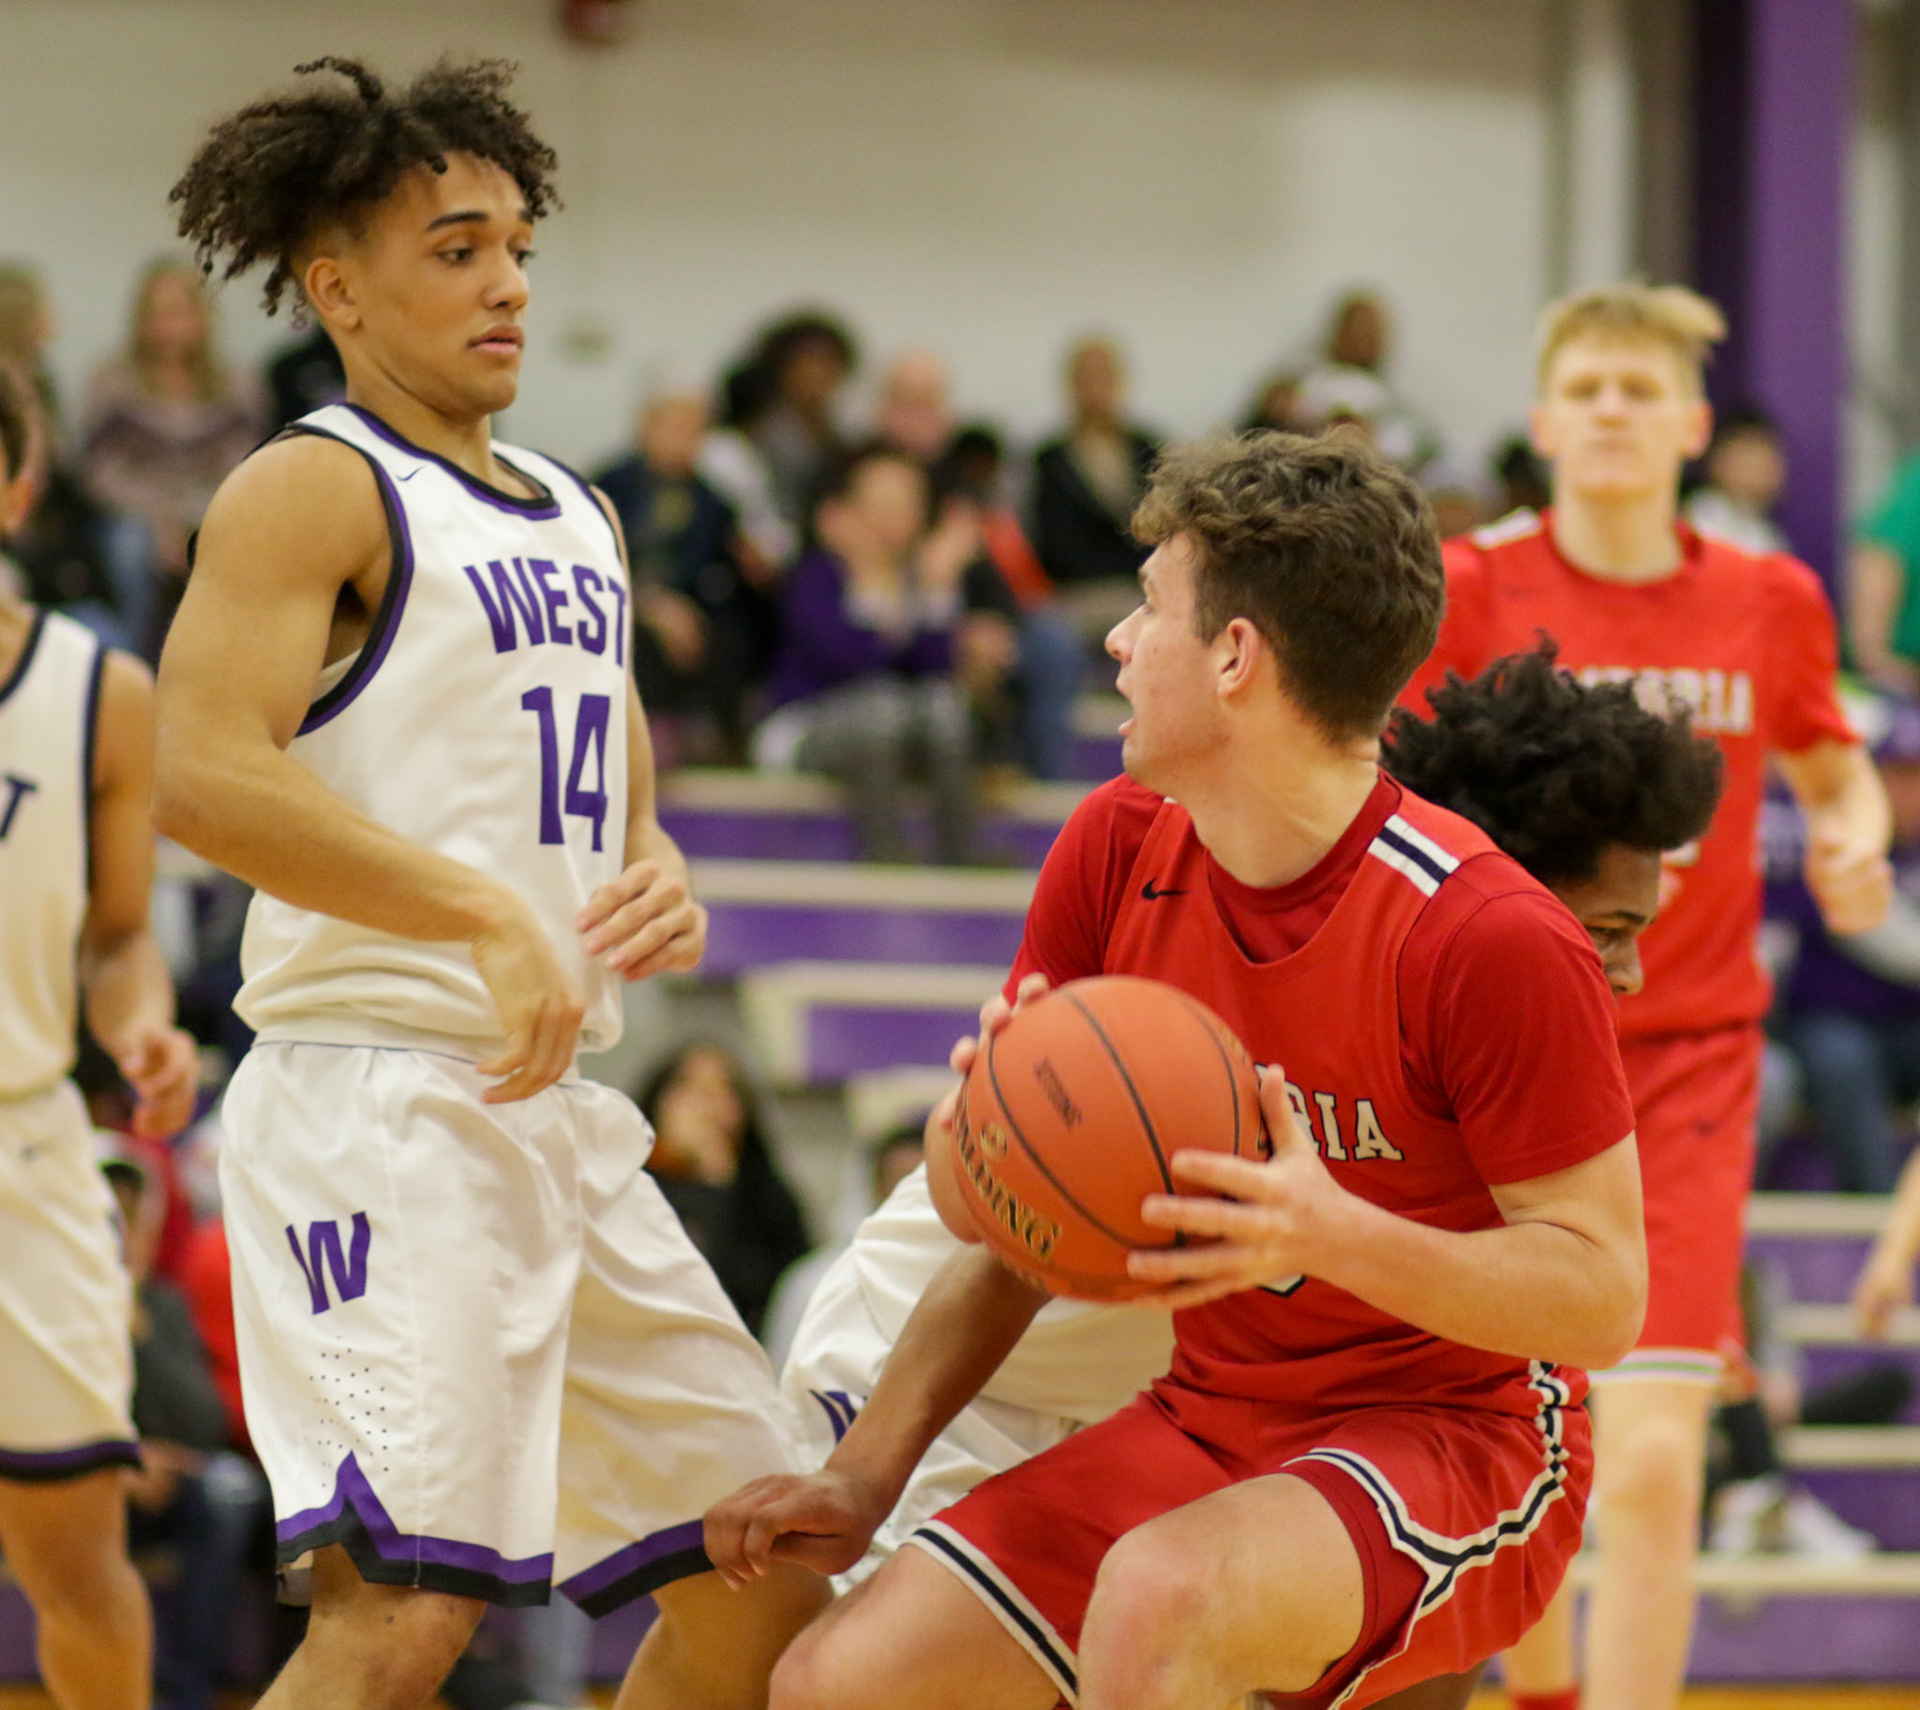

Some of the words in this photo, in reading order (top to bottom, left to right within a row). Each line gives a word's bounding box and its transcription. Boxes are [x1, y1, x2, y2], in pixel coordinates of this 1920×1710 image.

[463, 556, 626, 668] WEST
[521, 685, 611, 853] 14
[285, 1210, 371, 1315] W
